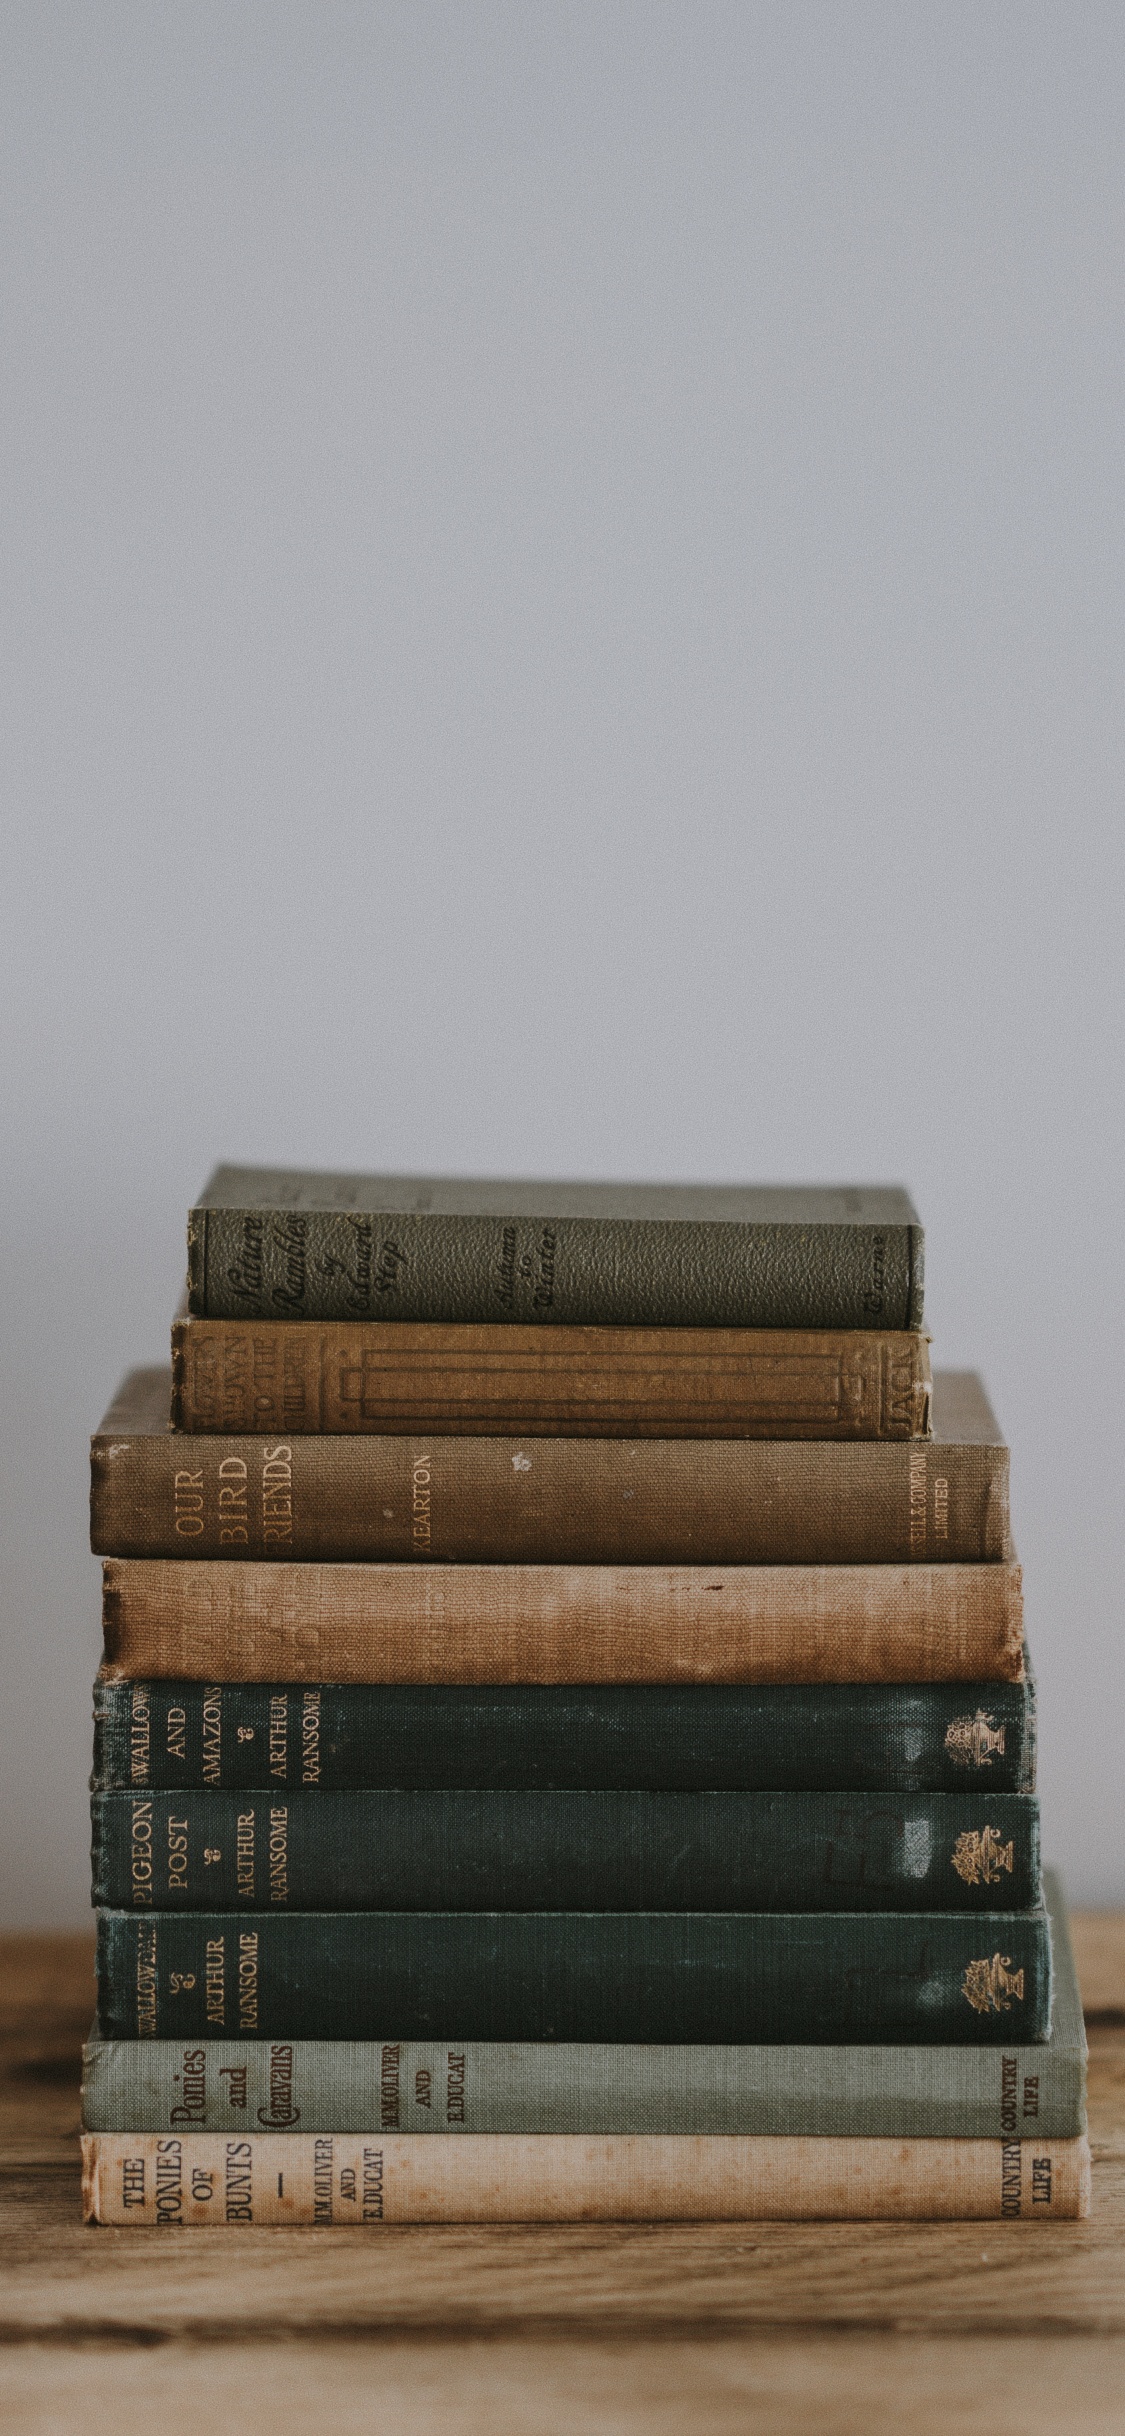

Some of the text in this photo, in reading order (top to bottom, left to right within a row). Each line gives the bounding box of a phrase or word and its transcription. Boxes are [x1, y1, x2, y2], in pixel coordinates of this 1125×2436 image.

[227, 1216, 262, 1313] Nature
[271, 1215, 305, 1315] Rambles
[314, 1254, 346, 1276] by
[346, 1217, 372, 1311] Edward
[374, 1240, 407, 1293] Step
[494, 1226, 516, 1310] Autumn
[516, 1255, 531, 1279] to
[253, 1338, 277, 1429] TO THE
[175, 1469, 204, 1536] OUR
[219, 1456, 249, 1545] BIRD
[412, 1455, 431, 1552] KEARTON
[909, 1451, 927, 1504] COMPANY
[909, 1506, 927, 1517] &
[934, 1478, 948, 1539] LIMITED
[166, 1707, 186, 1760] AND
[202, 1686, 222, 1786] AMAZONS
[269, 1694, 288, 1779] ARTHUR
[302, 1692, 321, 1783] RANSOME
[131, 1800, 153, 1905] PIGEON
[168, 1815, 188, 1889] POST
[237, 1809, 255, 1898] ARTHUR
[269, 1806, 290, 1901] RANSOME
[206, 1936, 225, 2026] ARTHUR
[239, 1932, 258, 2029] RANSOME
[169, 2049, 207, 2125] Ponies
[219, 2066, 248, 2109] and
[257, 2045, 300, 2128] Caravans
[415, 2069, 431, 2109] AND
[446, 2052, 466, 2124] E.DUCAT
[1000, 2055, 1018, 2132] COUNTRY
[1023, 2076, 1039, 2118] LIFE
[123, 2158, 145, 2208] THE
[155, 2140, 183, 2225] PONIES
[192, 2168, 214, 2202] OF
[226, 2142, 253, 2222] BUNTS
[340, 2168, 357, 2202] AND
[363, 2148, 385, 2220] E.DUCAT
[1001, 2136, 1021, 2217] COUNTRY
[1032, 2158, 1051, 2204] LIFE
